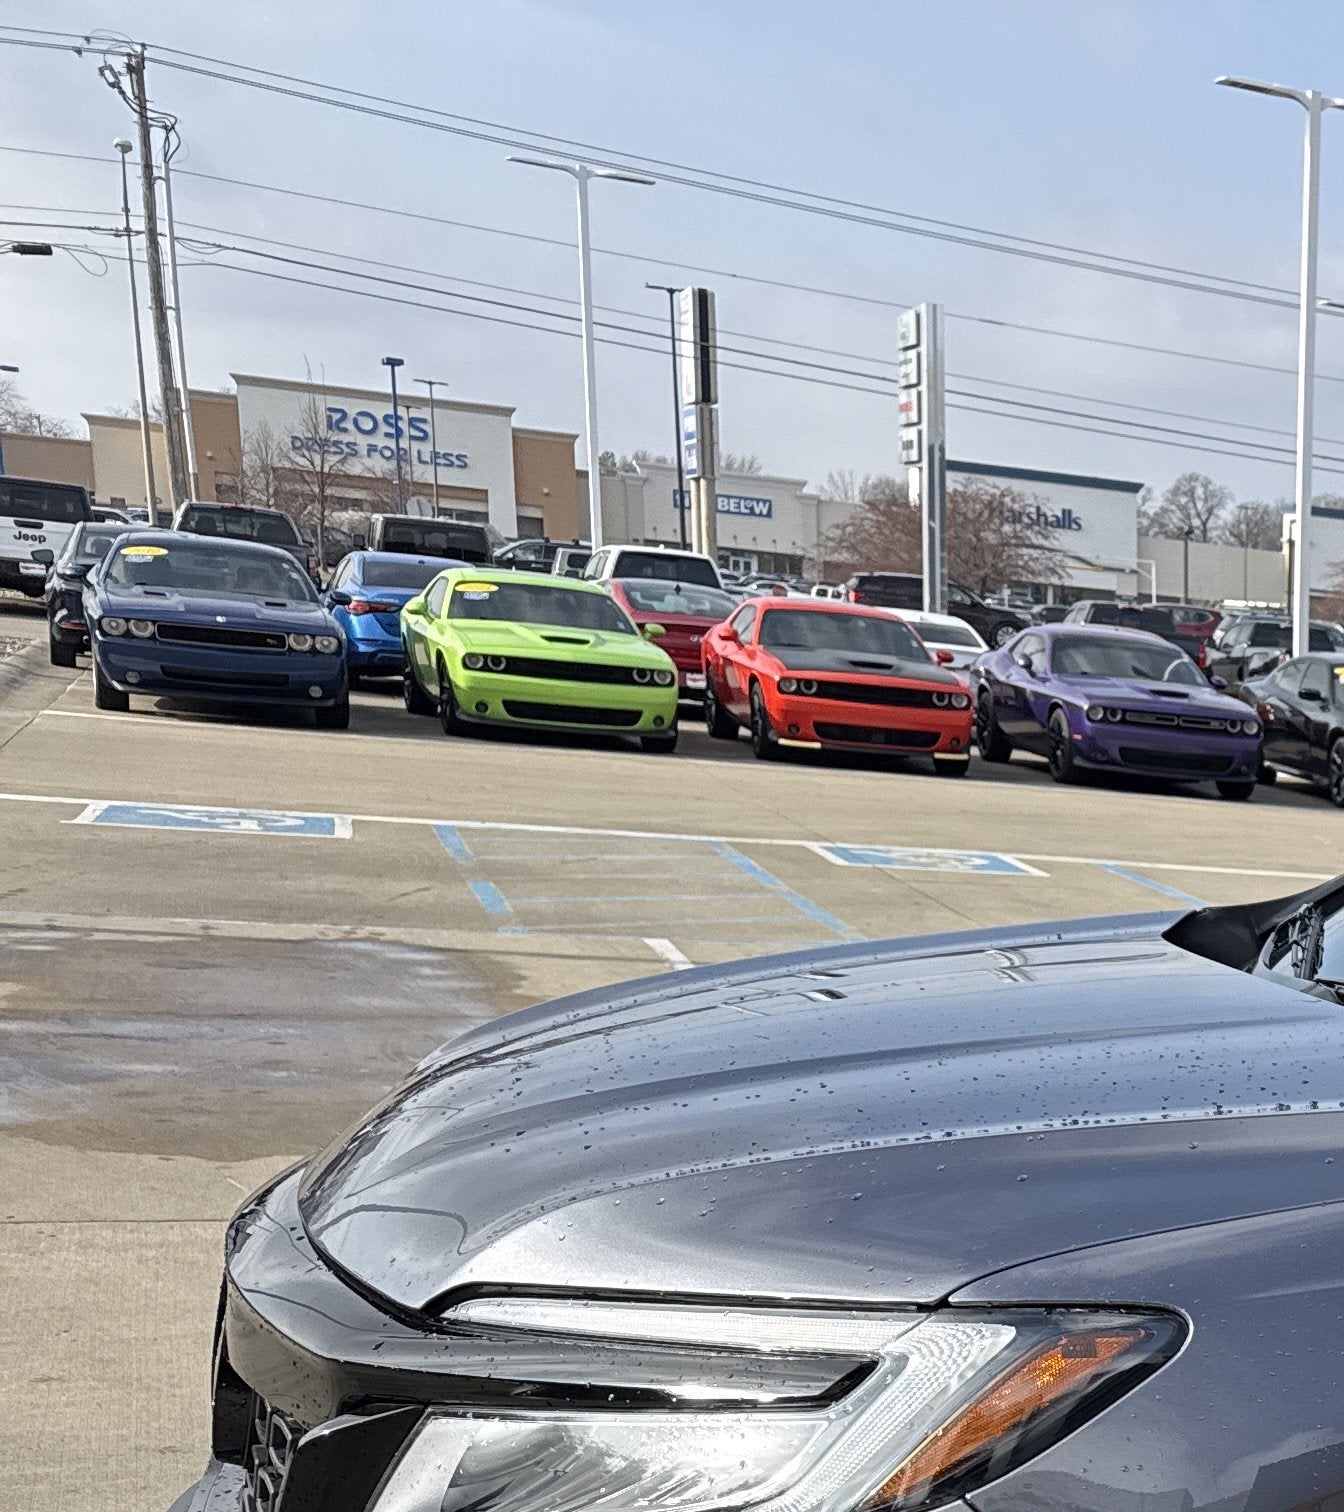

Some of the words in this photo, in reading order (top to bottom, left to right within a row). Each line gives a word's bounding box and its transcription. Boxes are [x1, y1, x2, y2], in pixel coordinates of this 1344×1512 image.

[326, 407, 429, 442] ROSS
[291, 435, 359, 457] DRESS
[366, 443, 408, 463] FOR
[417, 449, 469, 469] LESS
[13, 531, 47, 544] Jeep
